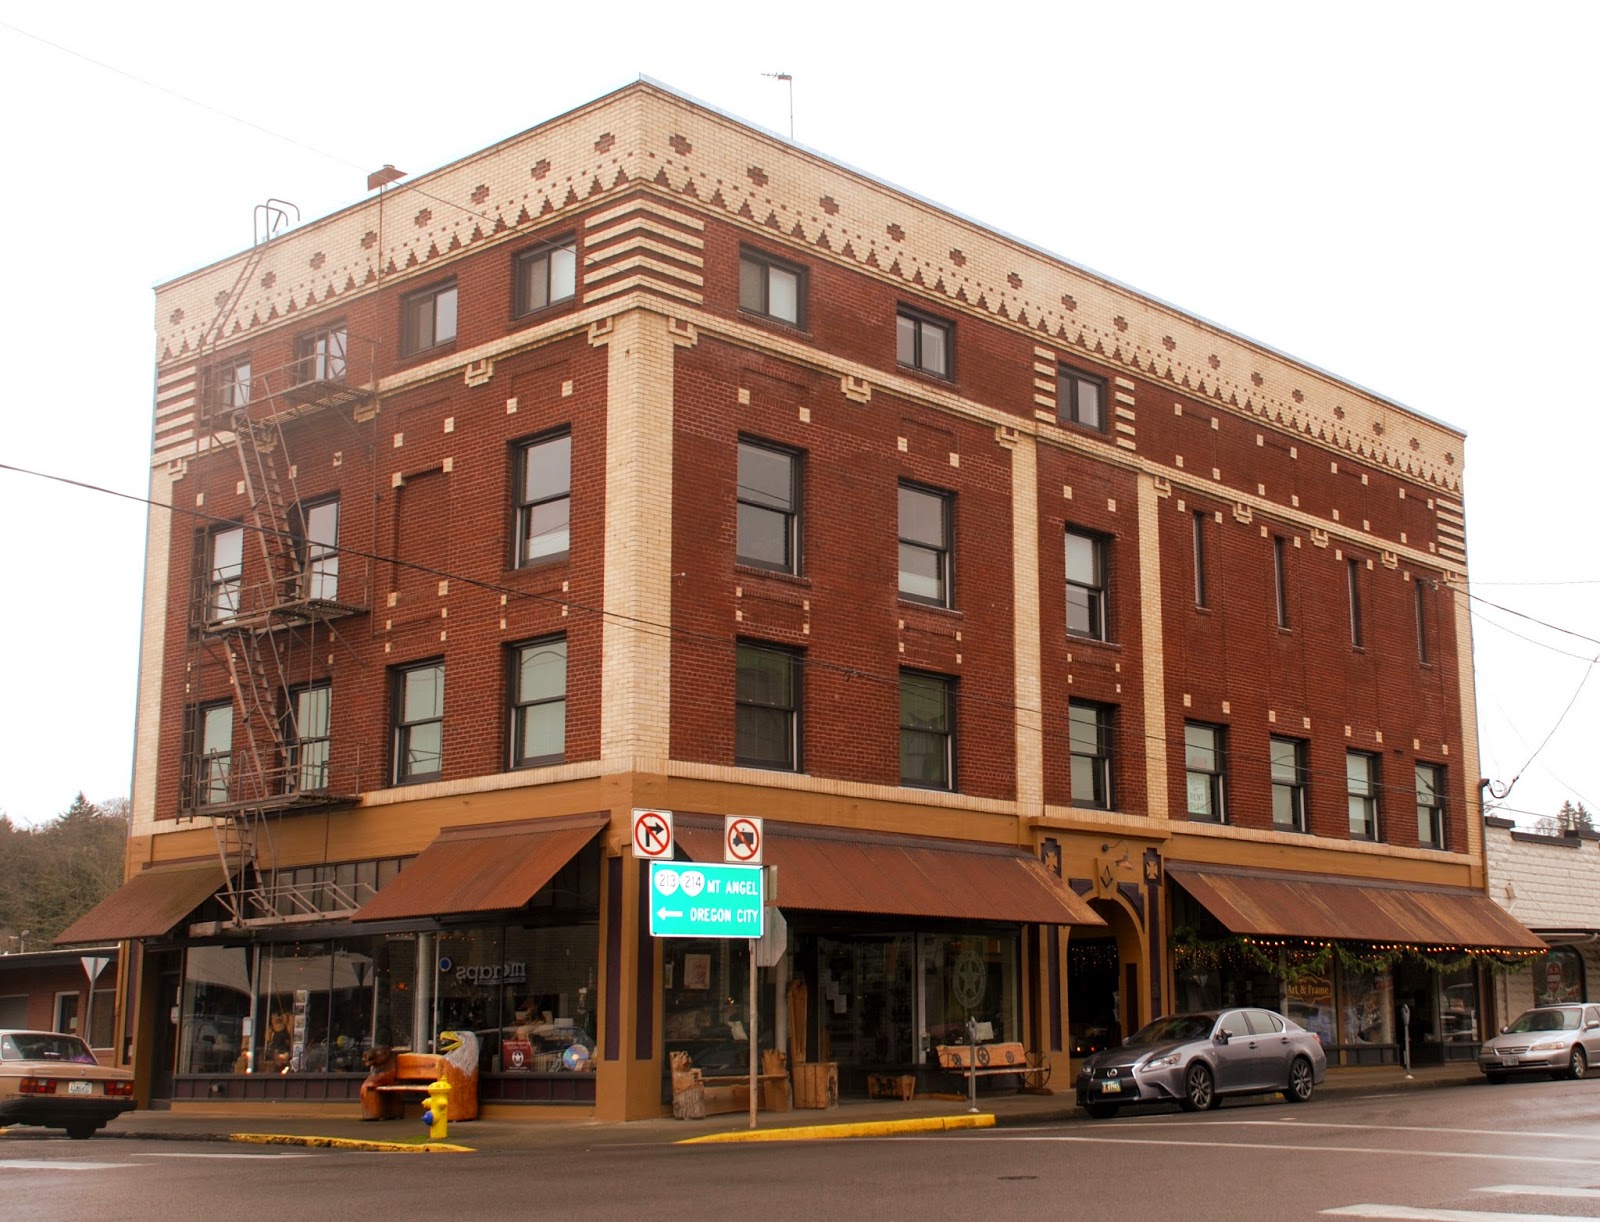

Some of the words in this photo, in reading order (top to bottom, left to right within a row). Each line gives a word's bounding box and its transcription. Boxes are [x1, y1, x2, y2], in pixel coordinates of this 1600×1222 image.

[659, 874, 676, 887] 213
[685, 875, 702, 888] 214
[707, 879, 721, 894] MT
[725, 880, 759, 896] ANGEL
[689, 907, 731, 923] OREGON
[736, 909, 759, 923] CITY
[1287, 984, 1300, 996] Art
[1308, 984, 1329, 996] Frame
